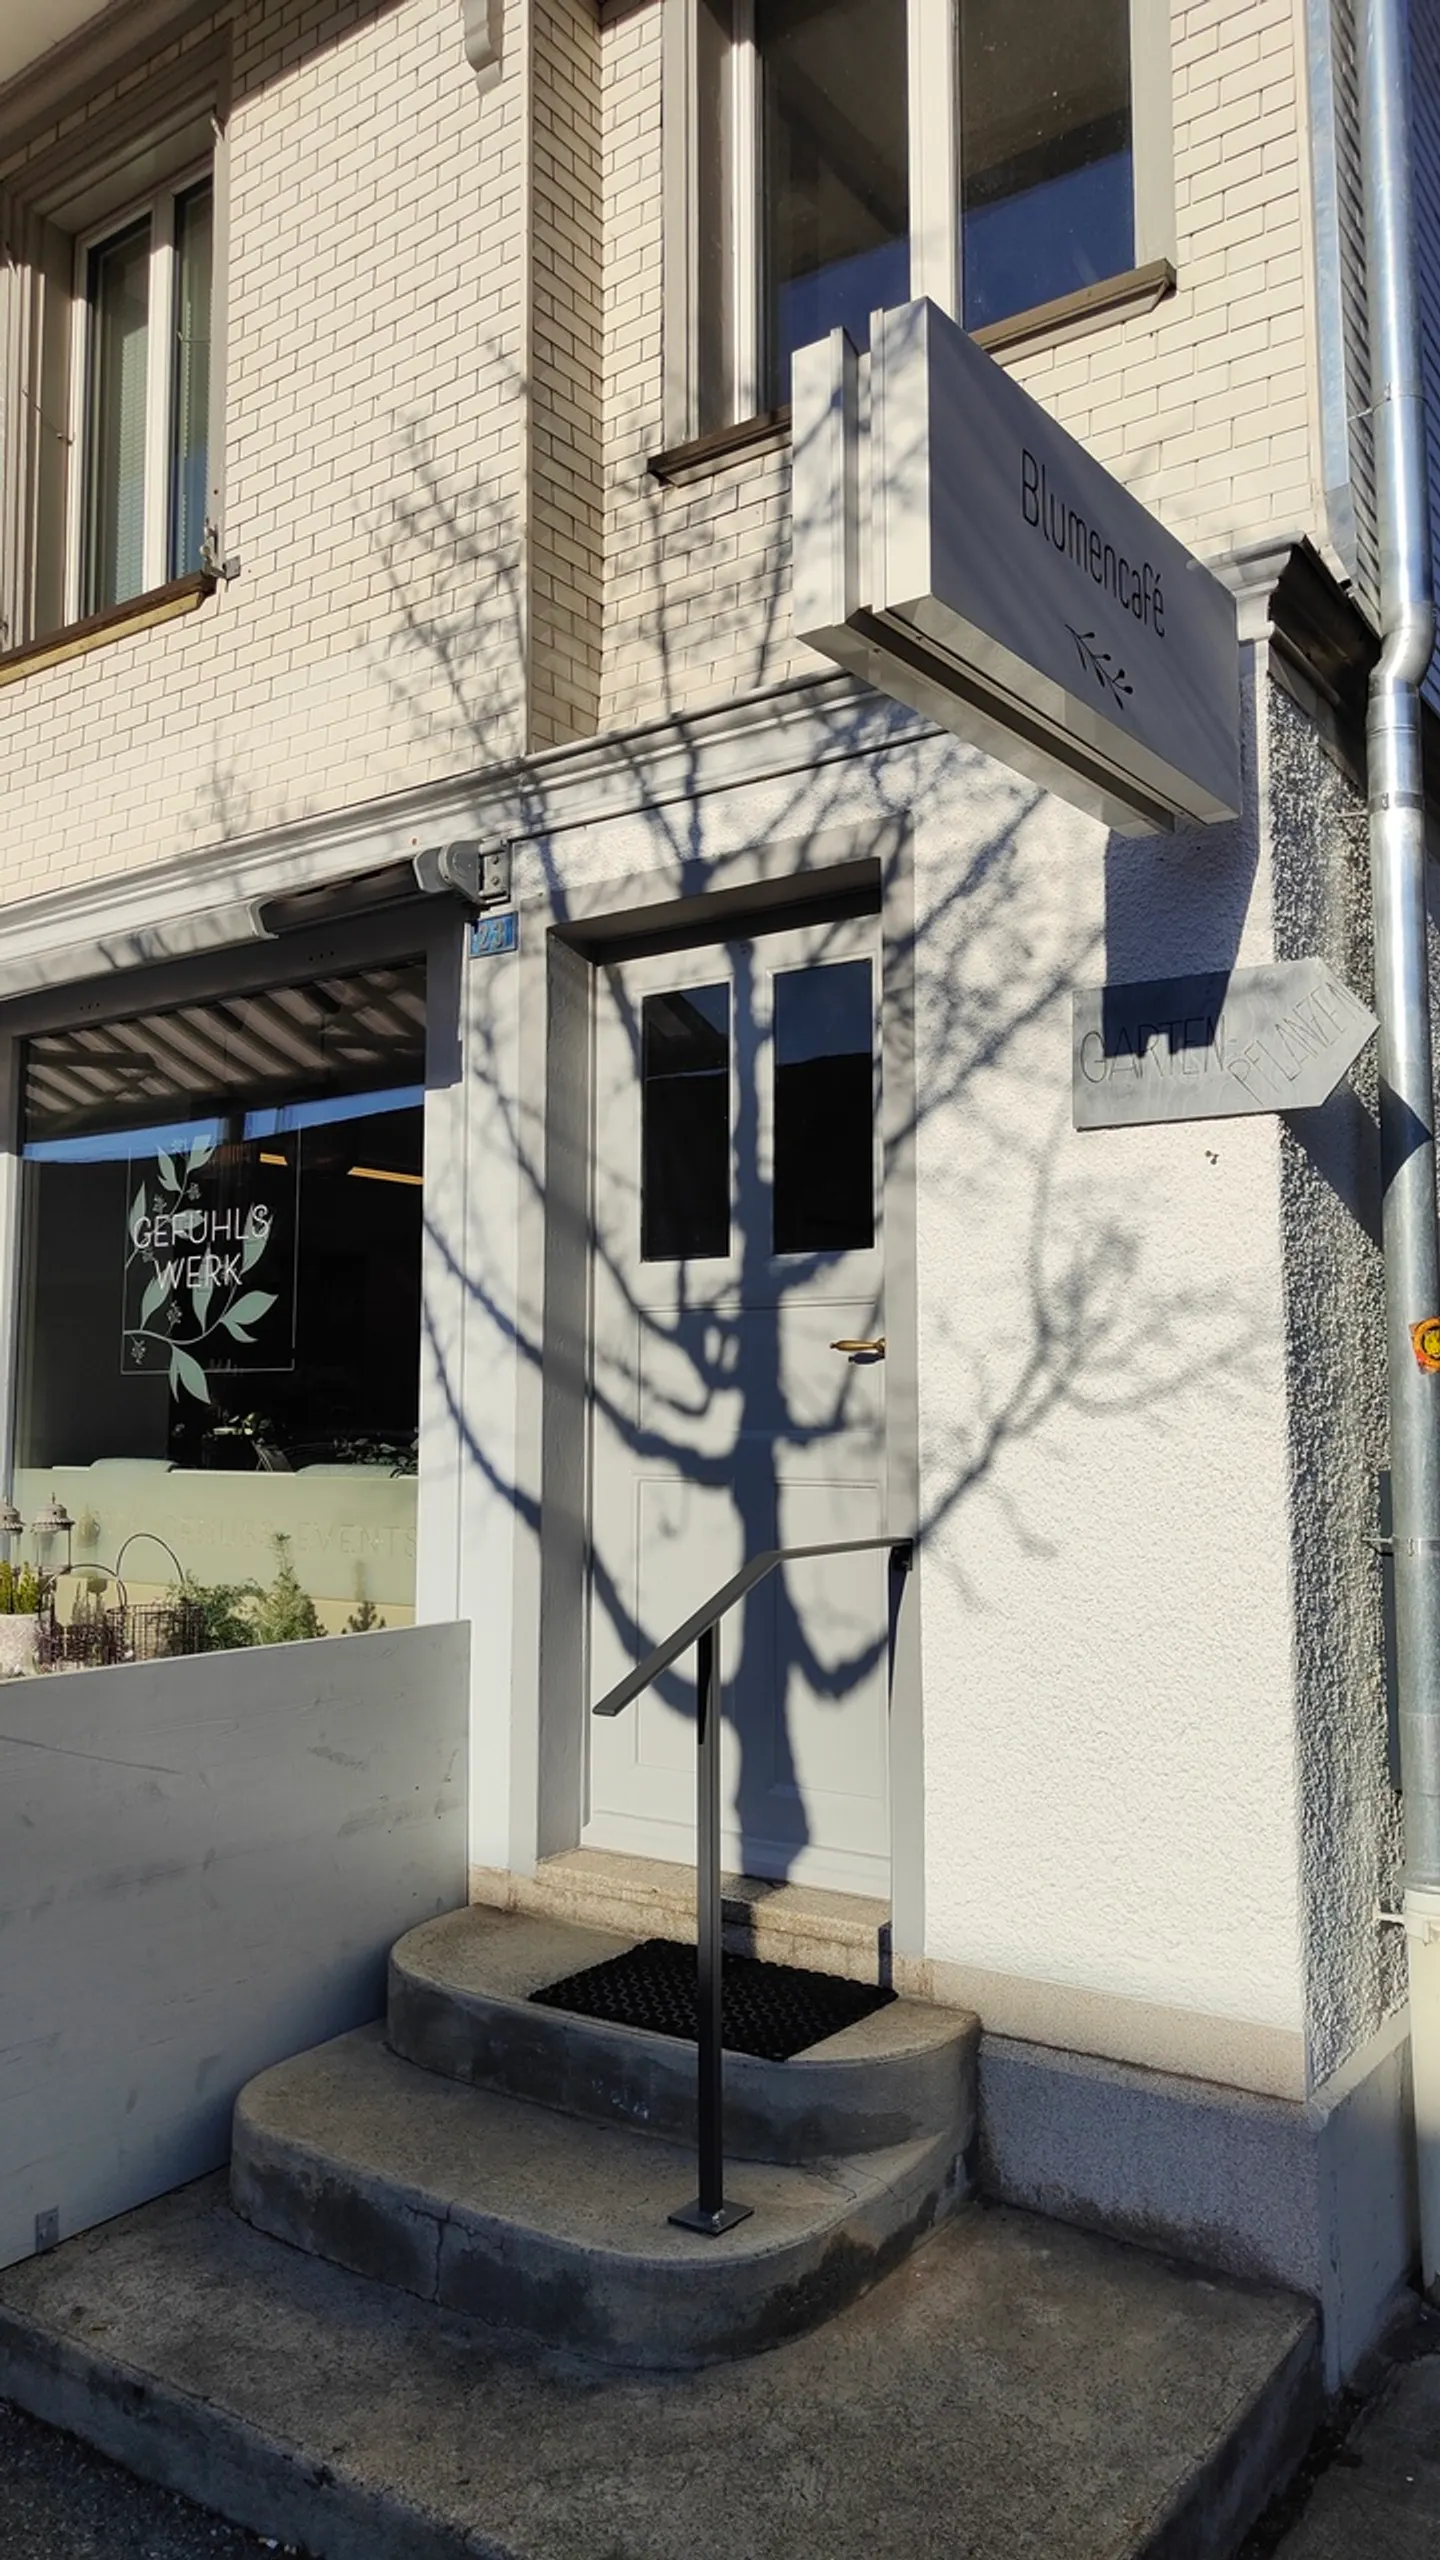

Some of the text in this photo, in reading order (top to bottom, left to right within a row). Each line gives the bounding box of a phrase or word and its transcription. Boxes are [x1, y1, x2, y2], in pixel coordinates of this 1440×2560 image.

[1021, 448, 1165, 638] Blumencafé
[1226, 976, 1365, 1107] PFLANZEN
[153, 1252, 243, 1290] WERK
[298, 1521, 416, 1558] EVENTS
